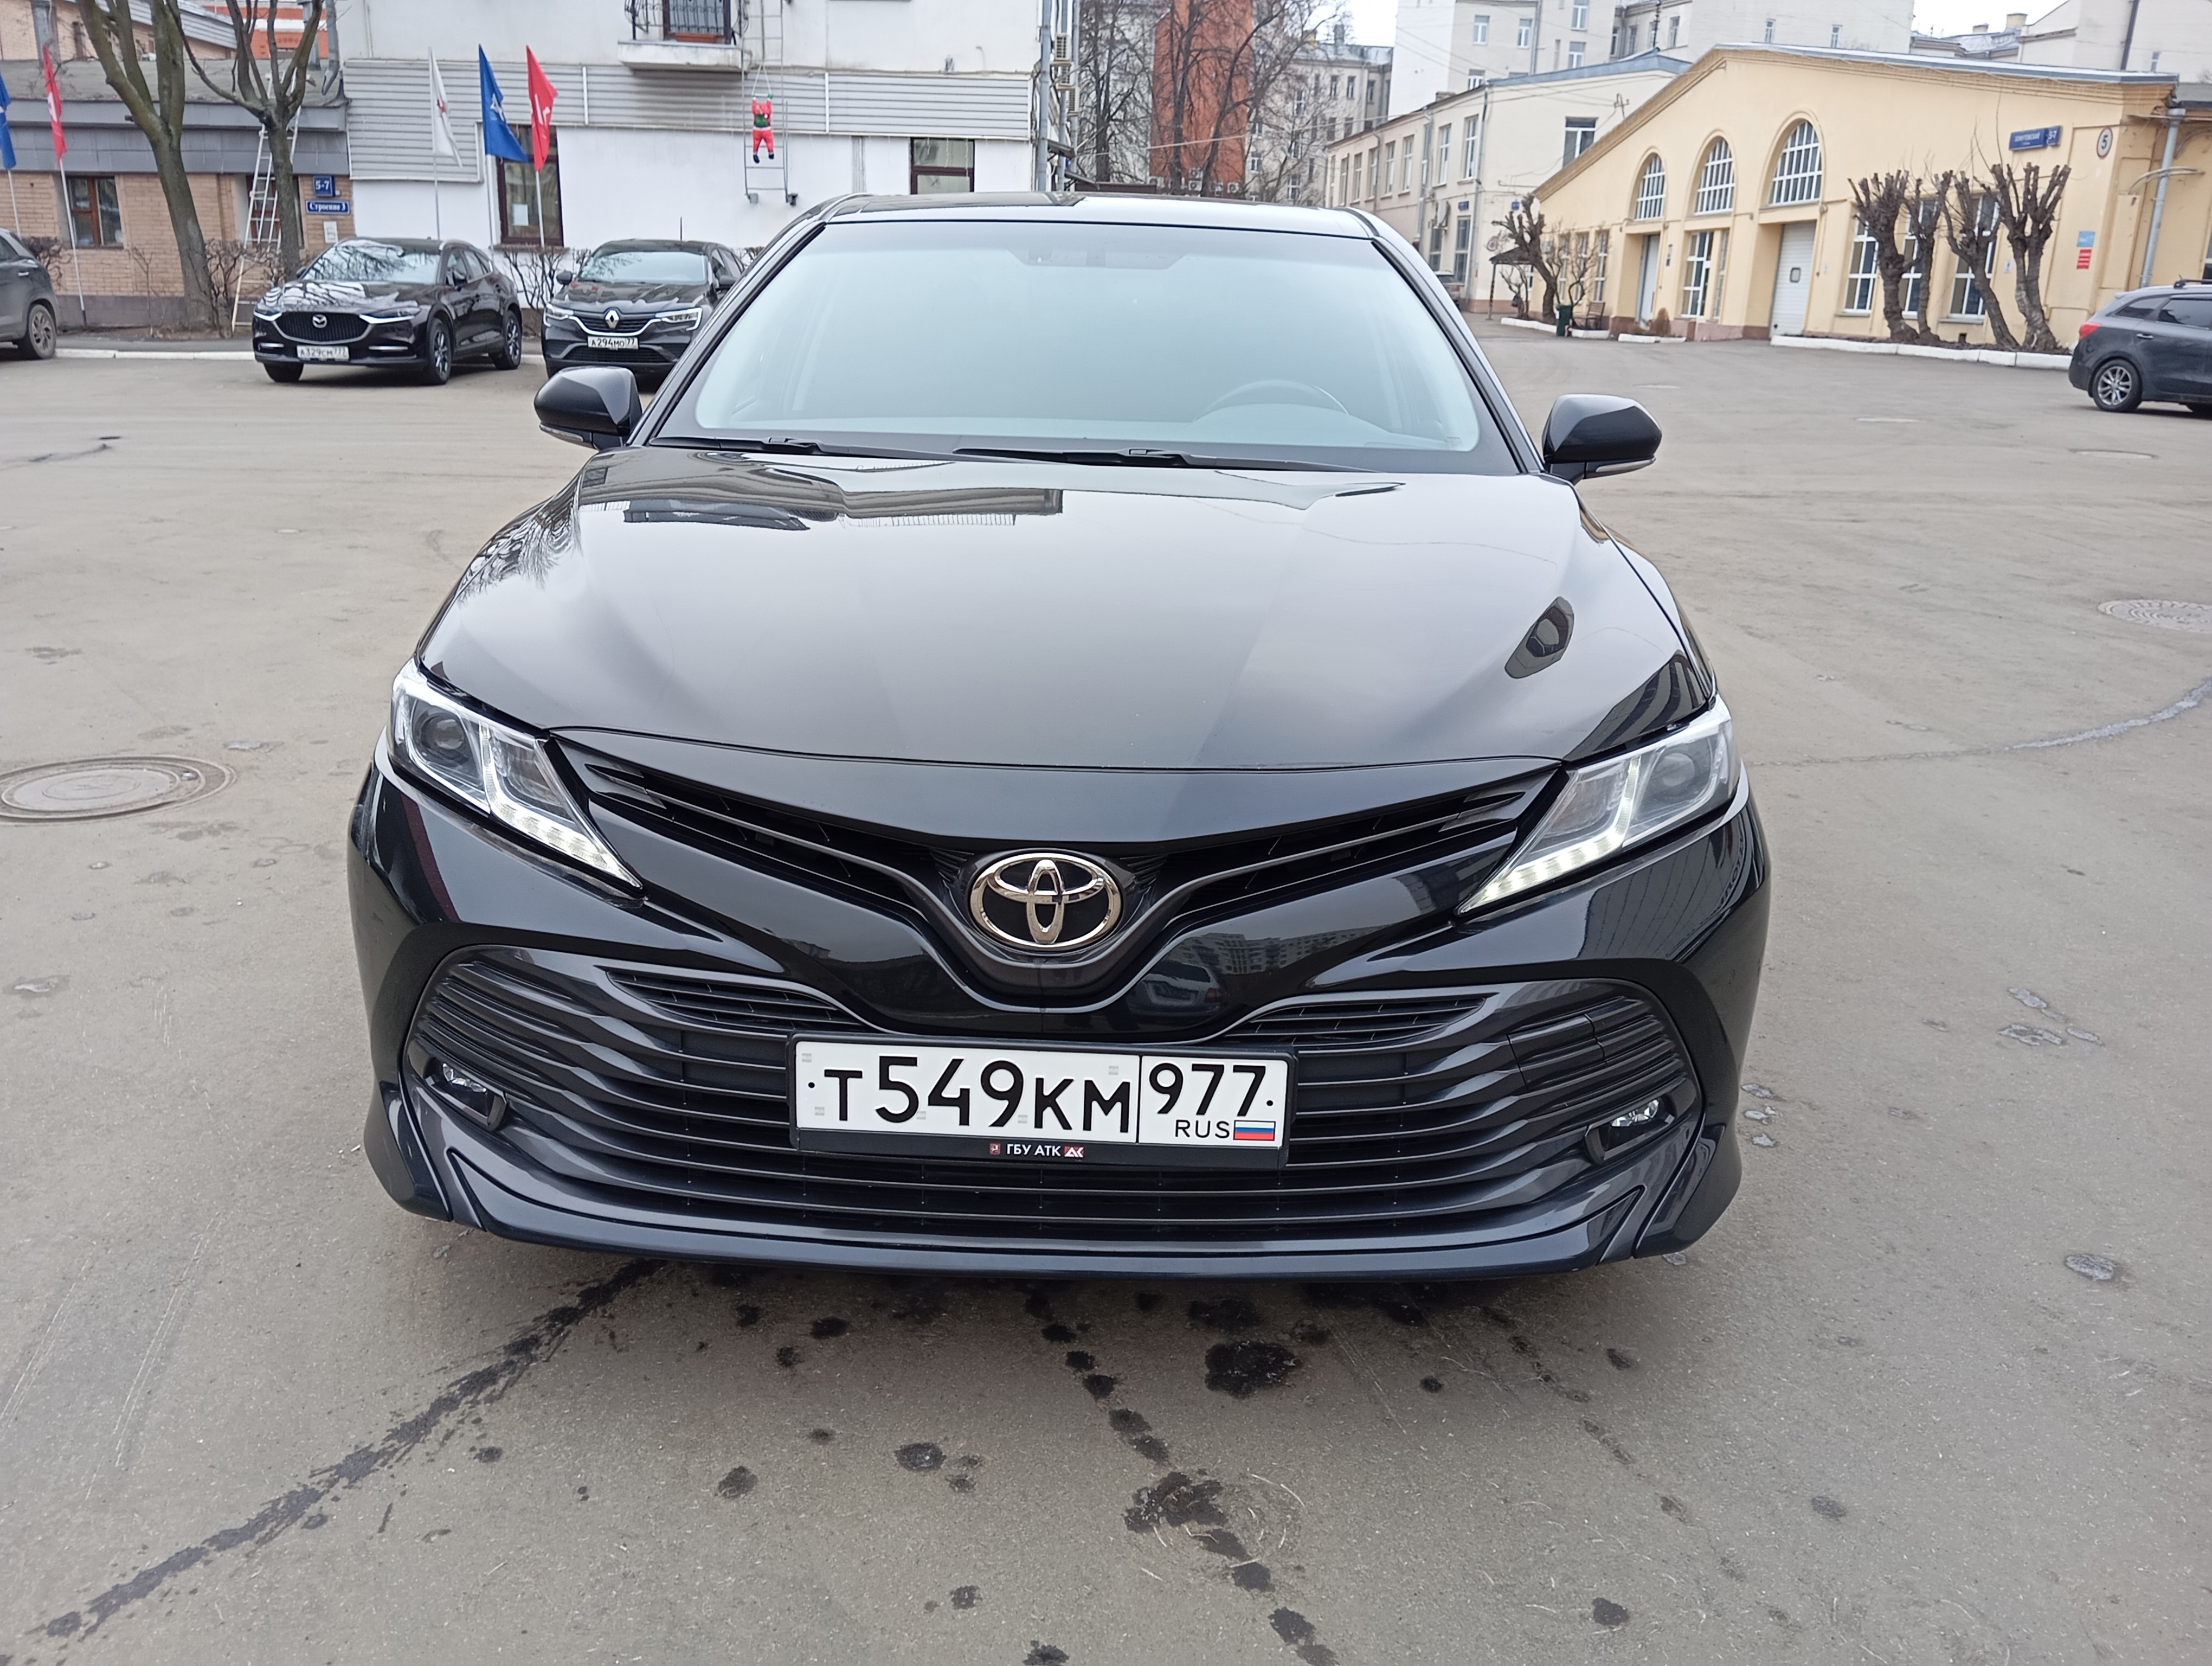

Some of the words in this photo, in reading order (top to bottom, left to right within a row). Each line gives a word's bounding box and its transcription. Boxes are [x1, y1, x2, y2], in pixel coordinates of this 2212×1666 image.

[2101, 134, 2108, 150] 5
[315, 180, 330, 190] 5-7
[1174, 1119, 1231, 1138] RUS
[1006, 1143, 1032, 1155] ГБУ
[1034, 1144, 1062, 1157] АТК
